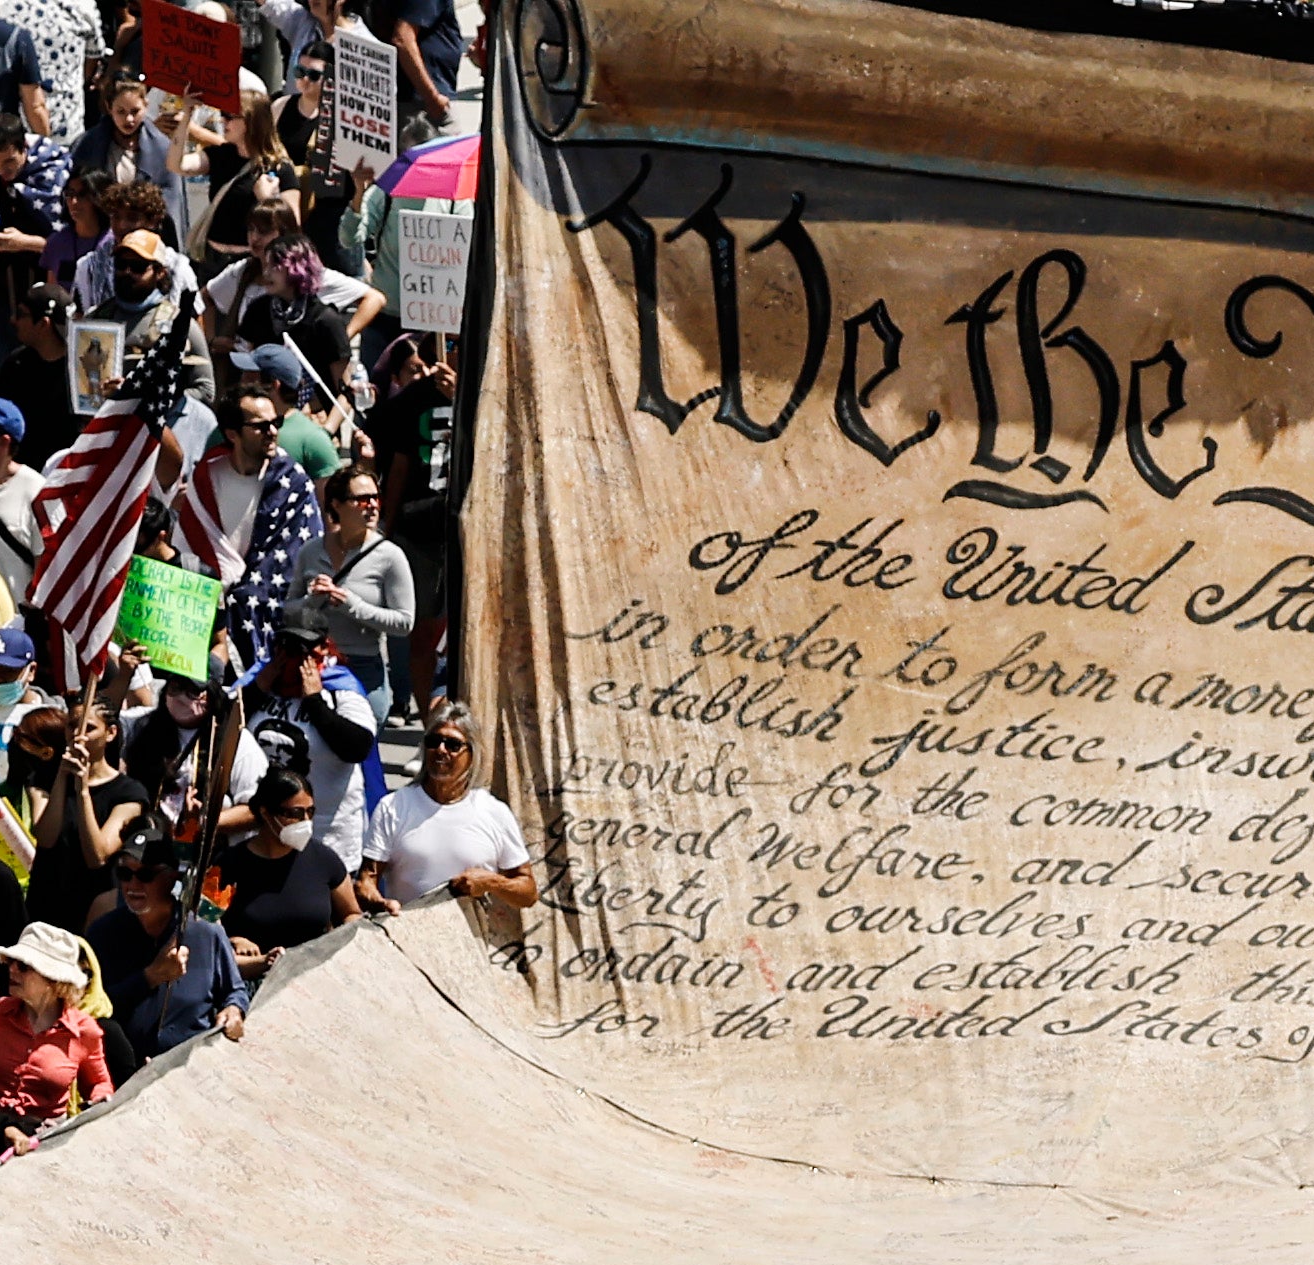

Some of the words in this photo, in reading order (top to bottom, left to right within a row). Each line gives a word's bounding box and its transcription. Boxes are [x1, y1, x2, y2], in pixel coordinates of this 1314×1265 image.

[341, 94, 364, 114] HOW
[368, 99, 390, 119] YOU
[341, 111, 391, 135] LOSE
[341, 129, 391, 154] THEM
[566, 154, 941, 465] We
[943, 248, 1216, 511] the
[690, 509, 817, 593] of
[779, 518, 917, 588] the
[945, 527, 1194, 614] United
[568, 599, 668, 650] in
[690, 606, 865, 679] order
[883, 627, 957, 686] to
[947, 631, 1117, 713] form
[1133, 671, 1175, 708] a
[1176, 676, 1314, 720] more
[589, 665, 857, 743] establish
[860, 708, 1124, 776] justice,
[536, 1002, 659, 1040] for
[701, 1000, 793, 1040] the
[818, 995, 1034, 1041] United
[1043, 997, 1263, 1048] States
